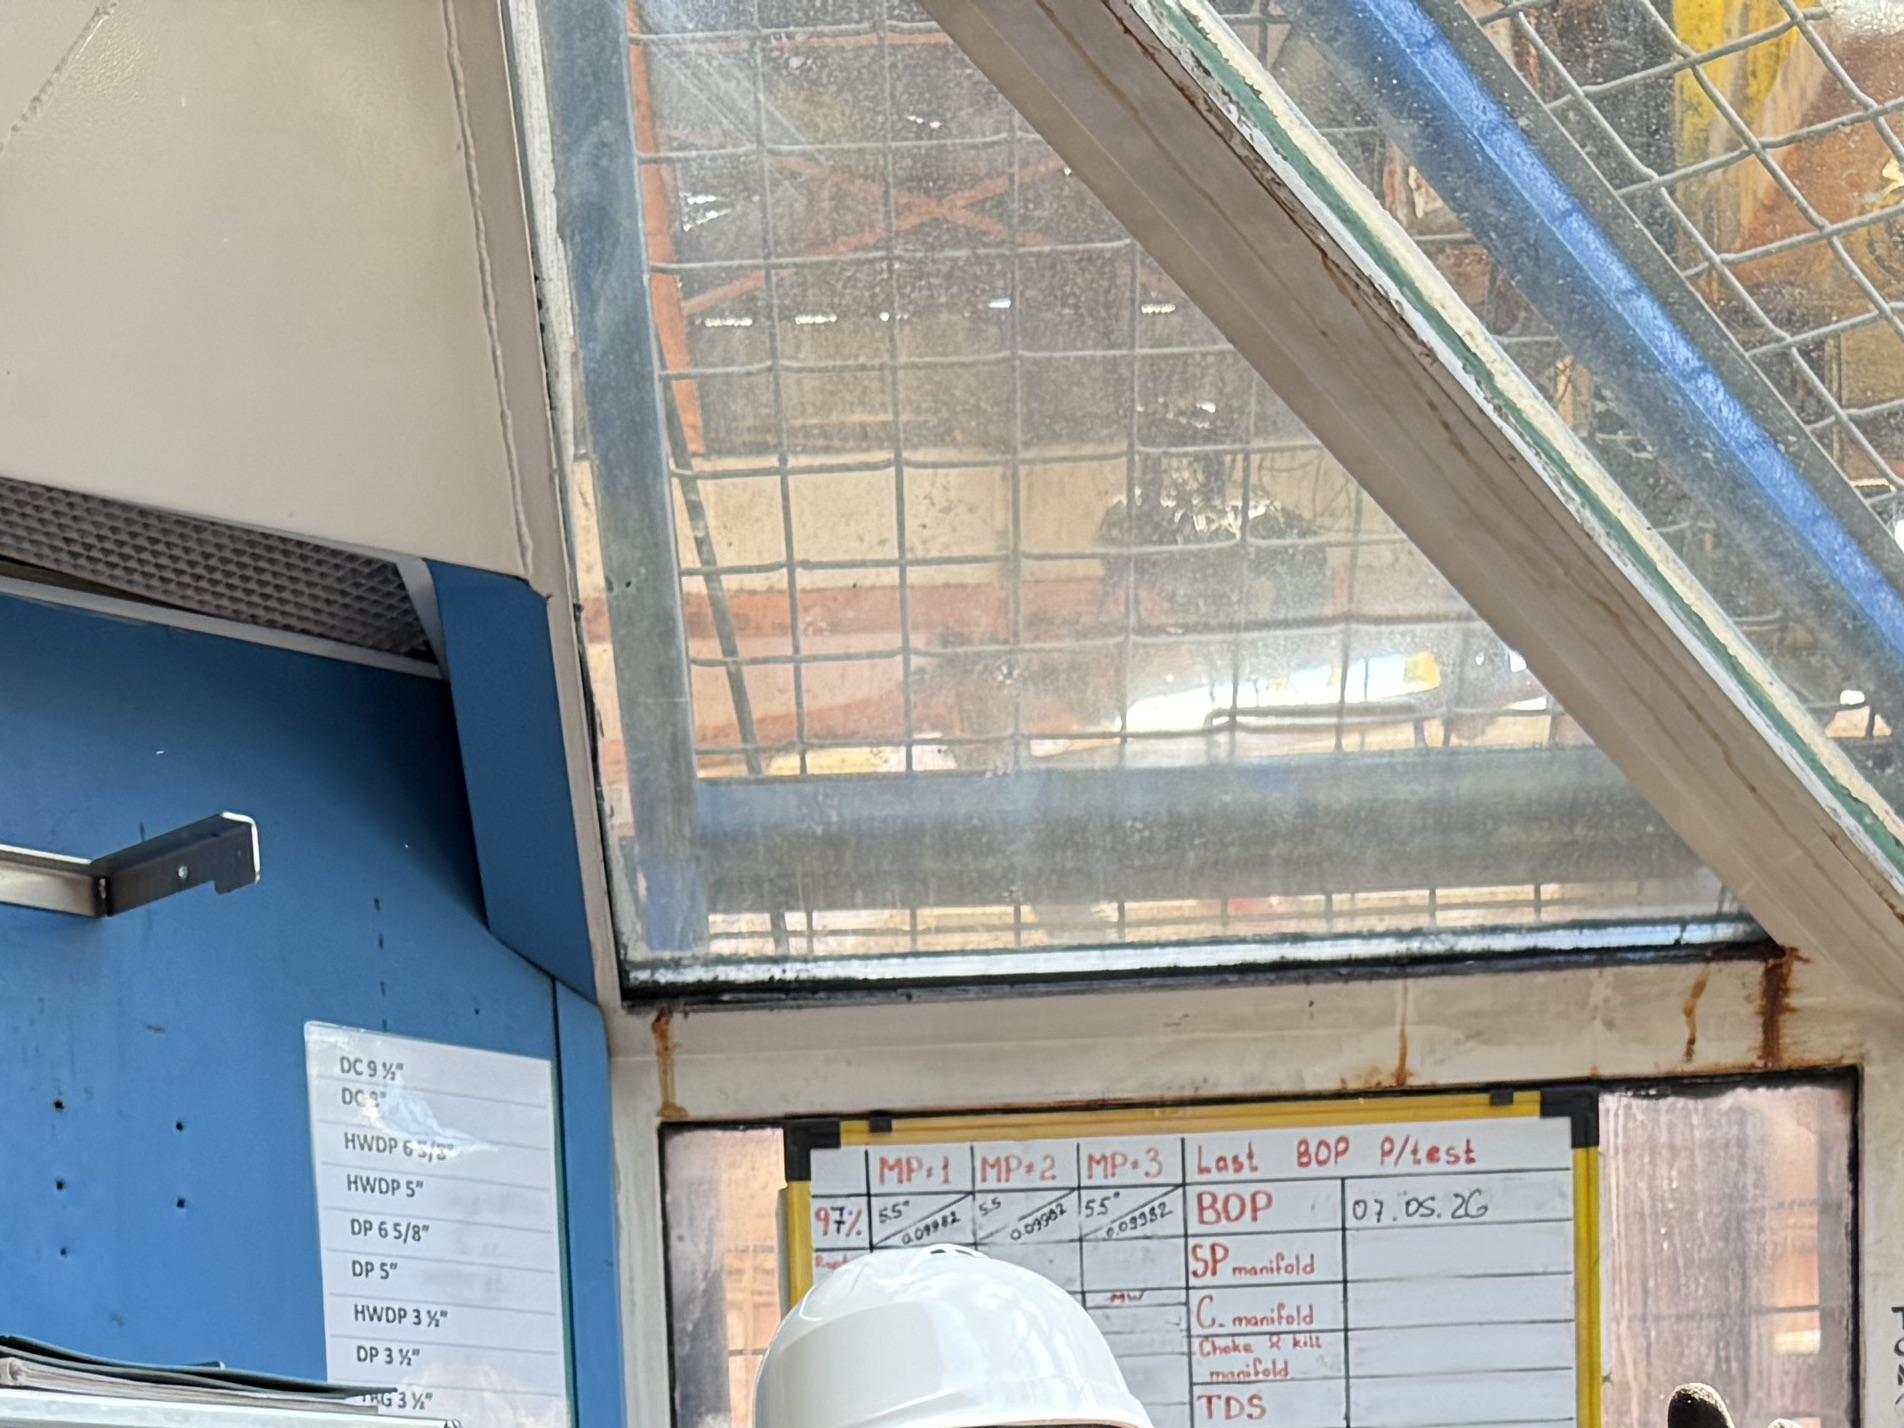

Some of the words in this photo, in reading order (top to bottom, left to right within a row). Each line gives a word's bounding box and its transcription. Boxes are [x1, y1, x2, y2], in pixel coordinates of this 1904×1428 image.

[339, 1056, 365, 1078] DC
[367, 1060, 378, 1079] 9
[344, 1132, 398, 1156] HWDP
[1198, 1142, 1259, 1176] Last
[1297, 1137, 1350, 1169] BOP
[1380, 1136, 1477, 1168] P/test
[346, 1174, 400, 1198] HWDP
[1197, 1190, 1274, 1226] BOP
[350, 1218, 373, 1238] DP
[378, 1221, 389, 1240] 6
[351, 1260, 374, 1279] DP
[1191, 1243, 1229, 1279] SP
[1232, 1253, 1315, 1277] manifold
[353, 1304, 408, 1325] HWDP
[412, 1308, 423, 1326] 3
[1232, 1303, 1314, 1328] manifold
[356, 1345, 380, 1364] DP
[383, 1348, 395, 1366] 3
[1199, 1338, 1254, 1358] Choke
[1209, 1358, 1289, 1382] manifold
[1198, 1394, 1267, 1421] TDS
